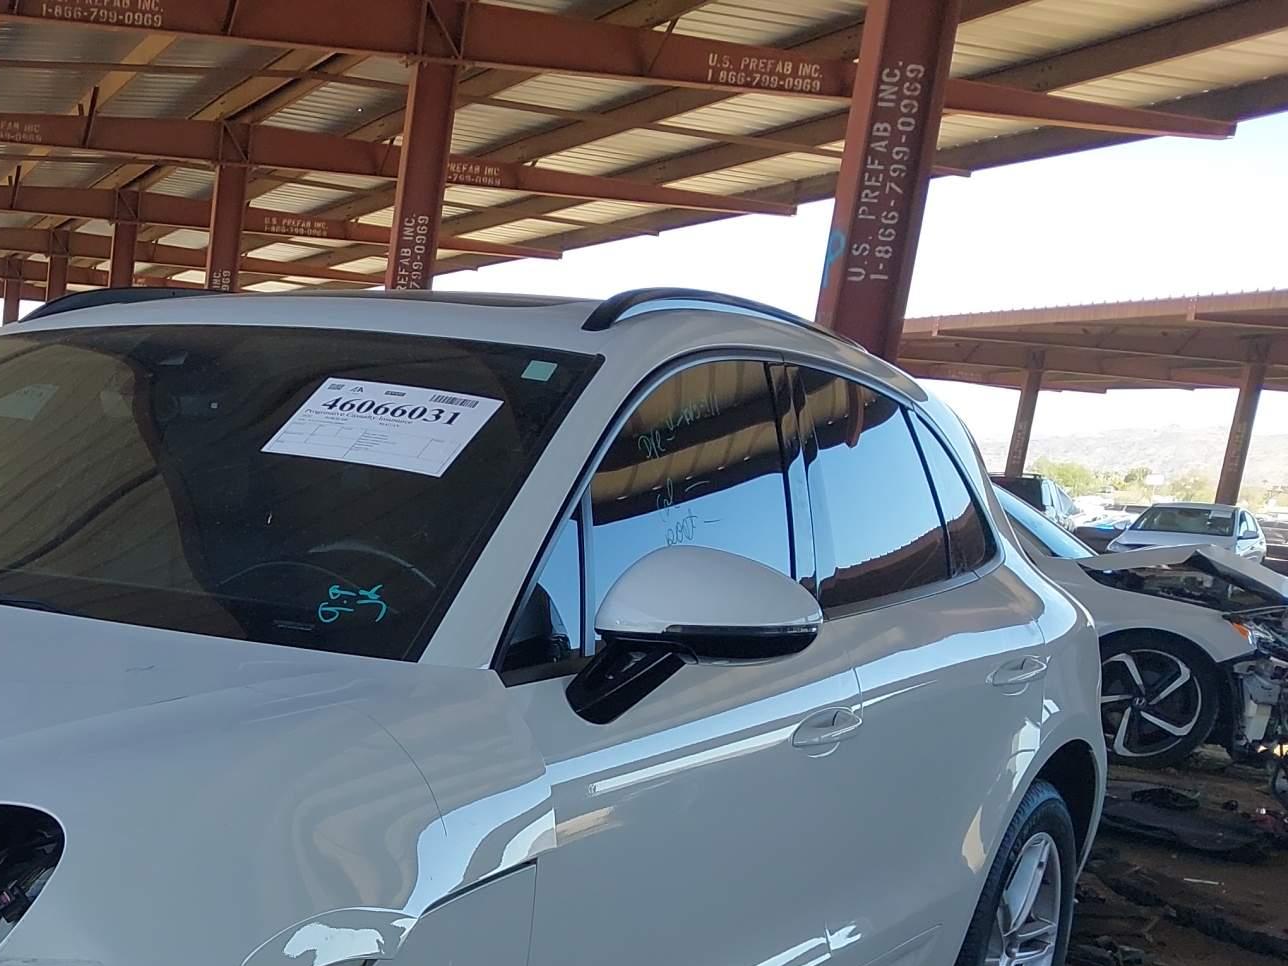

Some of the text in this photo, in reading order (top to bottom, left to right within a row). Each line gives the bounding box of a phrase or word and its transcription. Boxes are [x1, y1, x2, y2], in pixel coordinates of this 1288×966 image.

[41, 3, 163, 27] 1-866-799-0969
[707, 52, 823, 78] U.S. PREFAB INC.
[847, 60, 904, 282] U.S. PREFAB INC.
[870, 63, 925, 281] 1-866-799-0969
[397, 213, 416, 290] REFAB INC.
[410, 215, 429, 289] 799-0969
[321, 396, 461, 426] 46066031
